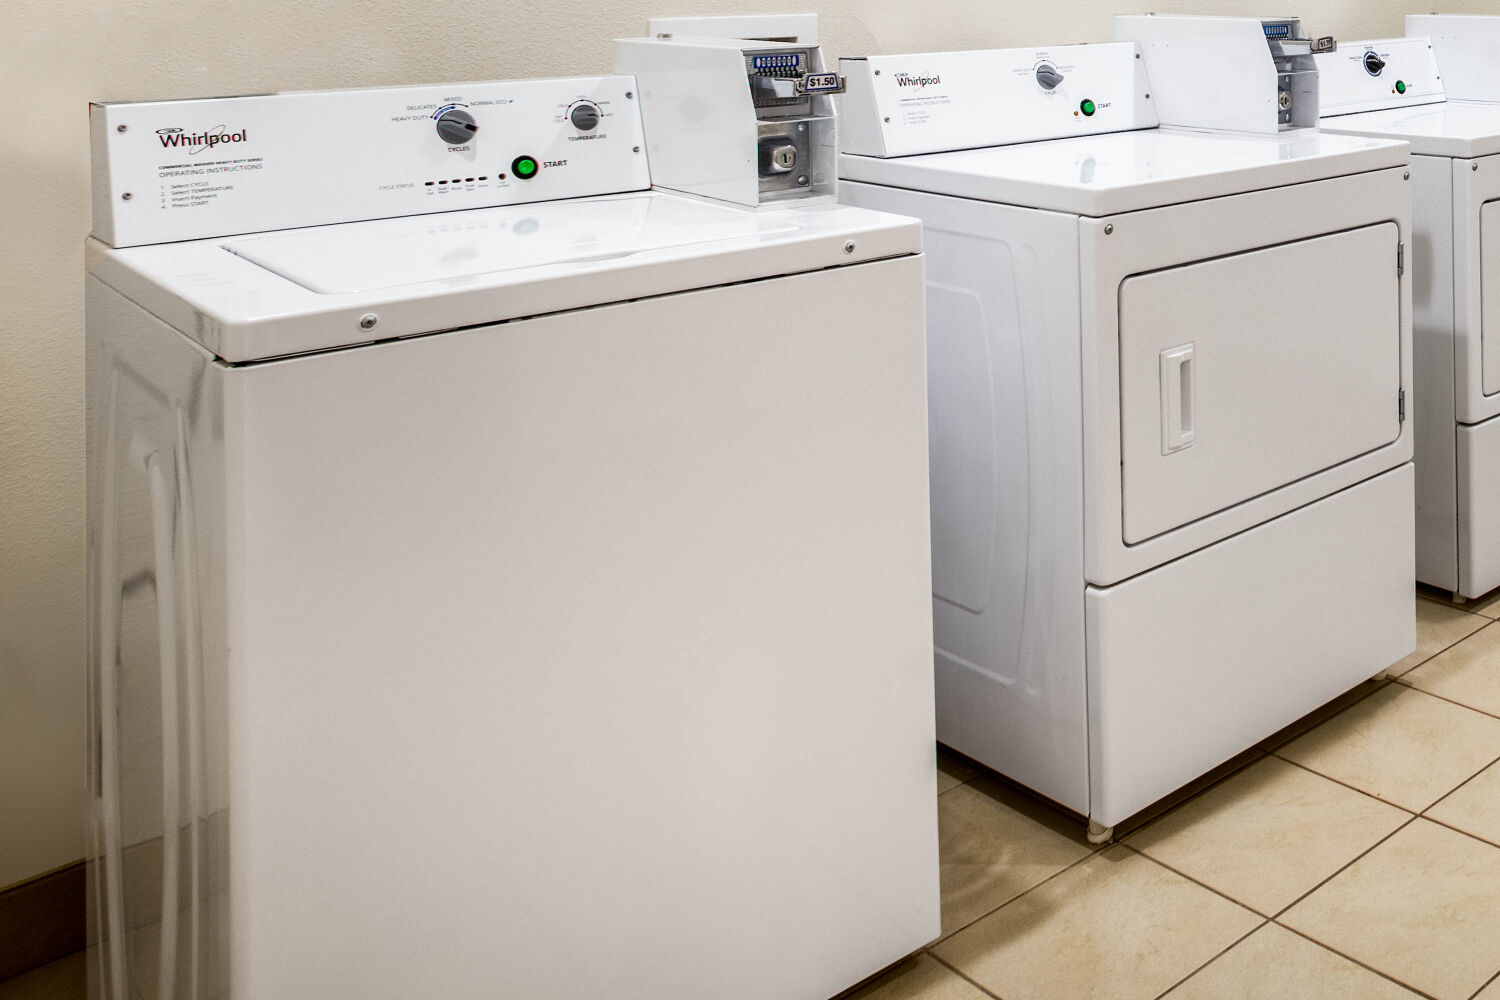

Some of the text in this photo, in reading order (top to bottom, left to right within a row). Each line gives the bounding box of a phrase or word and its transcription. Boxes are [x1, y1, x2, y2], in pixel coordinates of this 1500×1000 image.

[810, 77, 835, 87] $1.50
[896, 75, 941, 88] Whirlpool
[159, 129, 247, 148] Whirlpool
[543, 160, 568, 168] START
[159, 164, 262, 178] OPERATING INSTRUCTIONS
